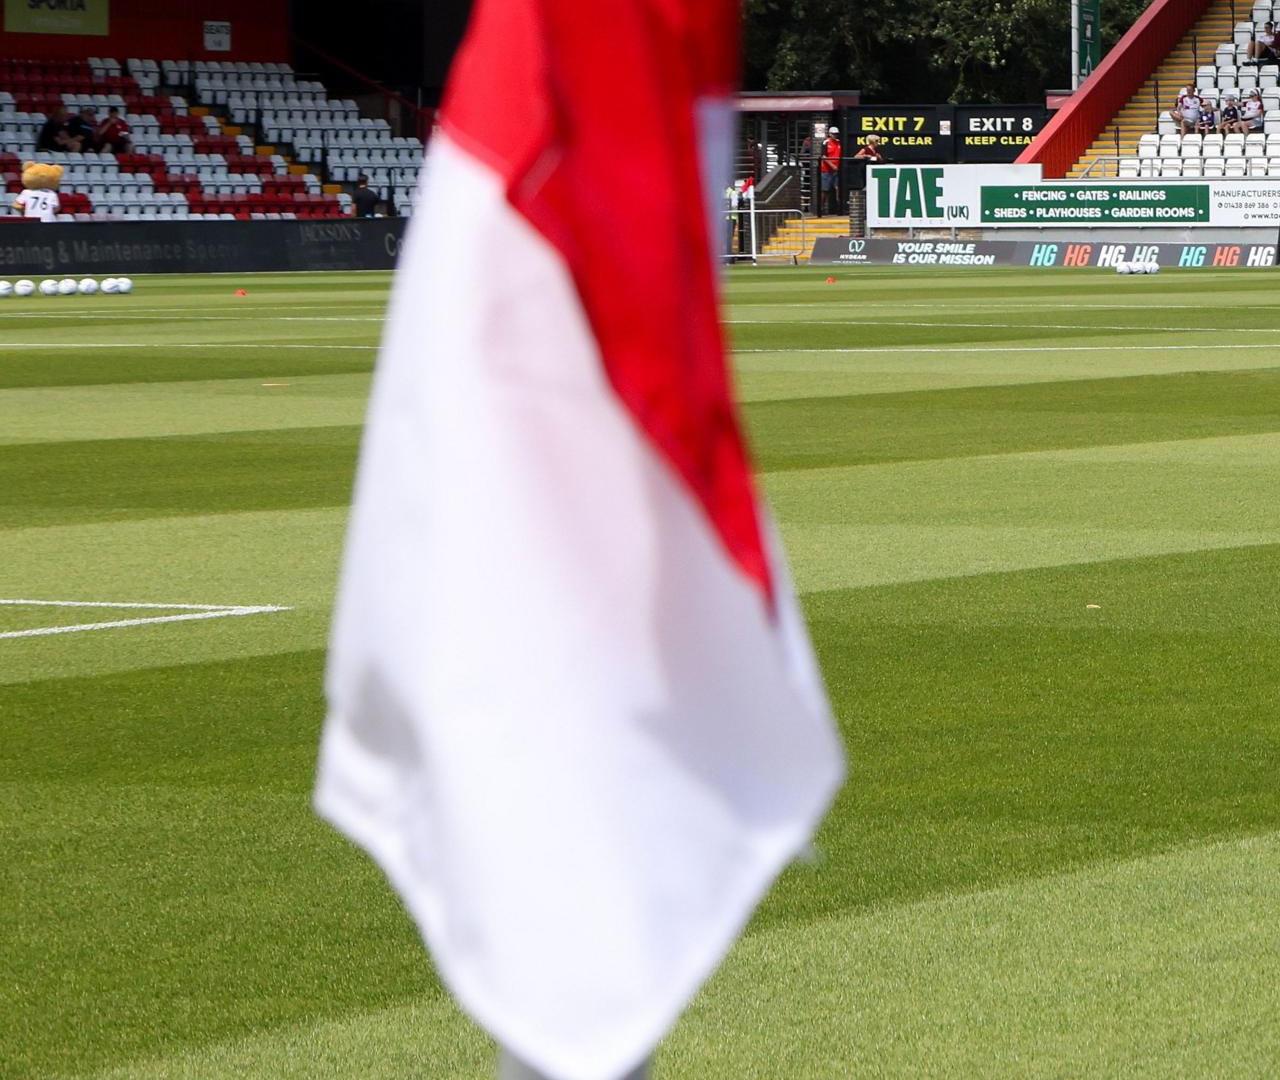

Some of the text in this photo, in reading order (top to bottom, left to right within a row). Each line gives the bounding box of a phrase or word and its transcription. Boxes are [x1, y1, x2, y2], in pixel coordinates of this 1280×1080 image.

[861, 117, 925, 131] EXIT 7
[969, 118, 1033, 132] EXIT 8
[857, 136, 933, 146] KP CLEAR
[965, 136, 997, 146] KEEP
[871, 168, 970, 220] TAE (UK)
[1022, 190, 1166, 201] FENCING GATES RAILINGS
[30, 196, 49, 211] 76
[993, 207, 1195, 218] SHEDS PLAYHOUSES GARDEN ROOMS
[73, 238, 184, 263] Maintenance
[897, 243, 976, 254] YOUR SMILE
[892, 253, 995, 265] IS OUR MISSION
[1029, 245, 1058, 266] HG
[1064, 245, 1092, 266] HG
[1097, 245, 1126, 267] HG
[1132, 246, 1160, 264] HG
[1178, 247, 1207, 267] HG
[1212, 247, 1240, 267] HG
[1246, 247, 1276, 267] HG
